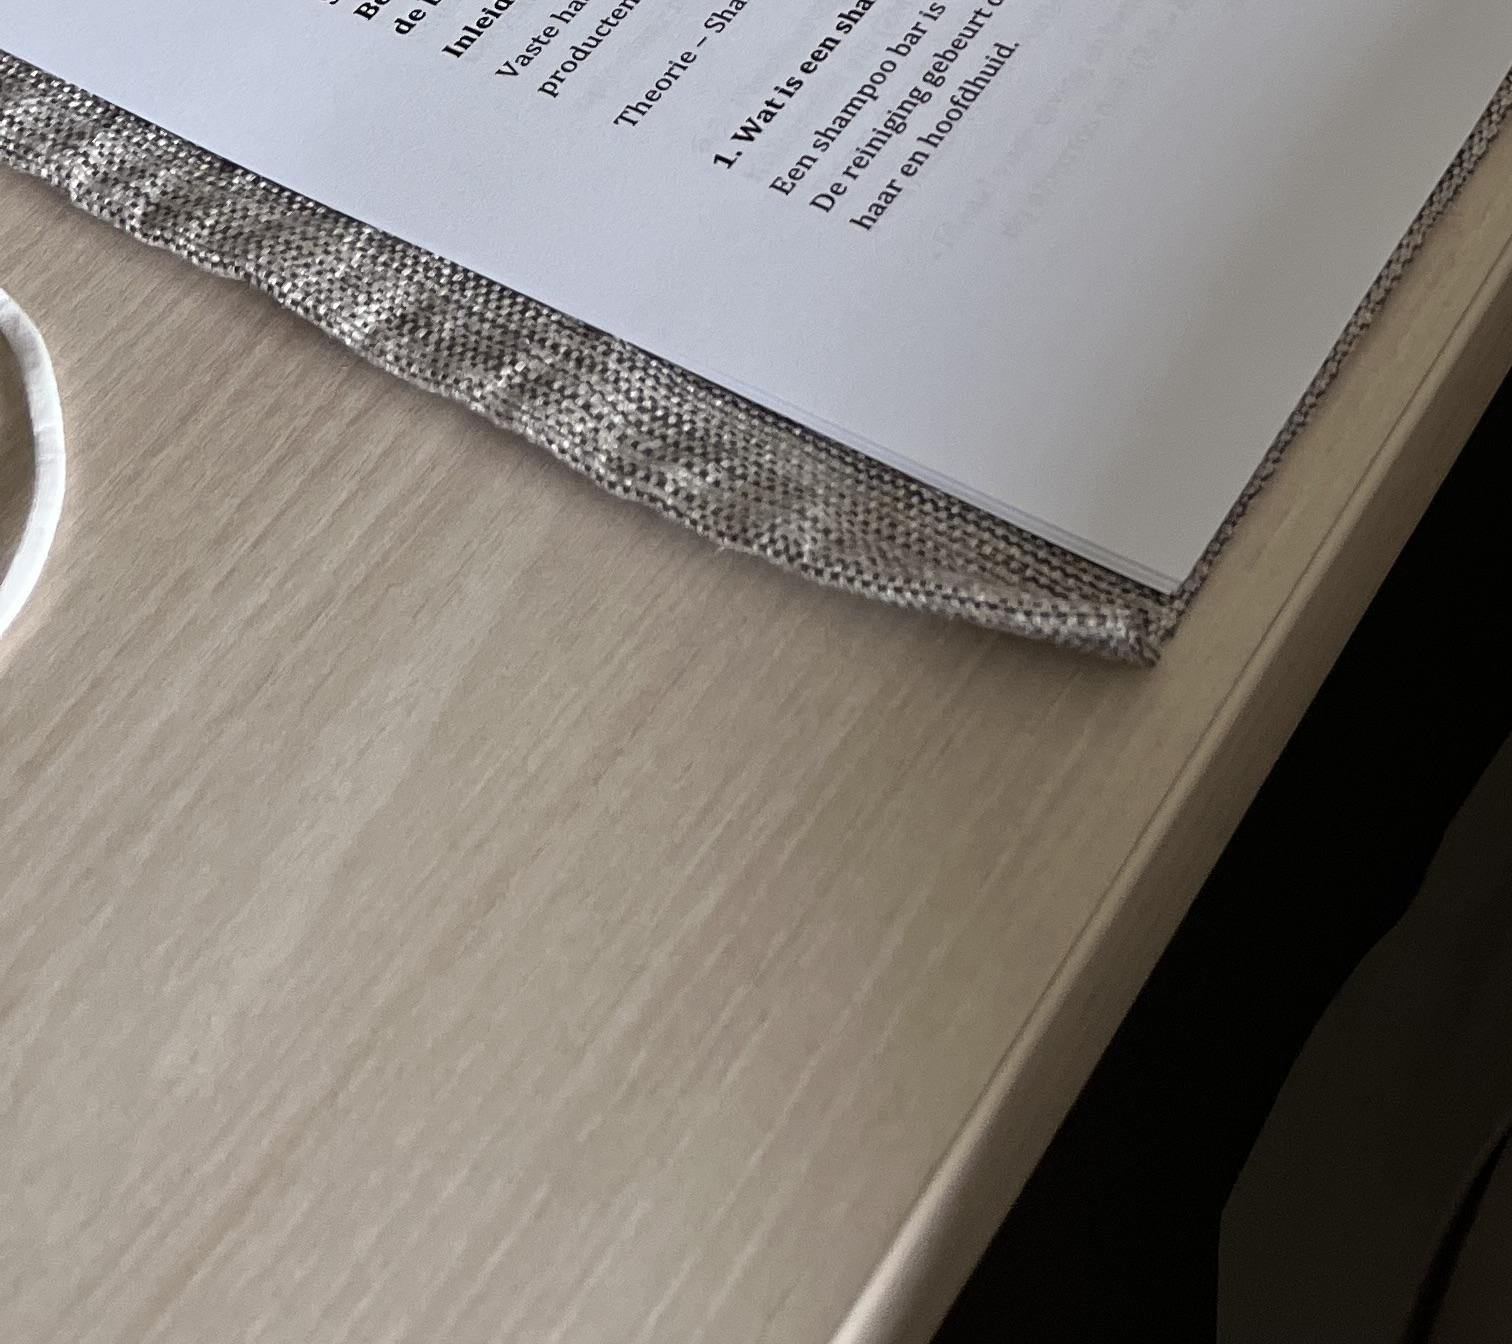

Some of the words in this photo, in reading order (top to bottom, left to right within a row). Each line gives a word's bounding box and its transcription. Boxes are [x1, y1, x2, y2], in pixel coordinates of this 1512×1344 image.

[393, 8, 427, 34] de
[494, 25, 560, 76] Vaste
[613, 51, 697, 126] Theorie
[713, 150, 743, 169] 1.
[730, 97, 786, 142] Wat
[773, 76, 804, 98] is
[799, 36, 842, 74] een
[768, 154, 819, 195] Een
[812, 59, 897, 152] shampoo
[885, 21, 928, 57] bar
[918, 1, 946, 21] is
[809, 181, 848, 212] De
[842, 85, 933, 180] reiniging
[922, 7, 993, 87] gebeurt
[849, 178, 903, 230] haar
[900, 150, 930, 177] en
[916, 42, 1020, 148] hoofdhuid.
